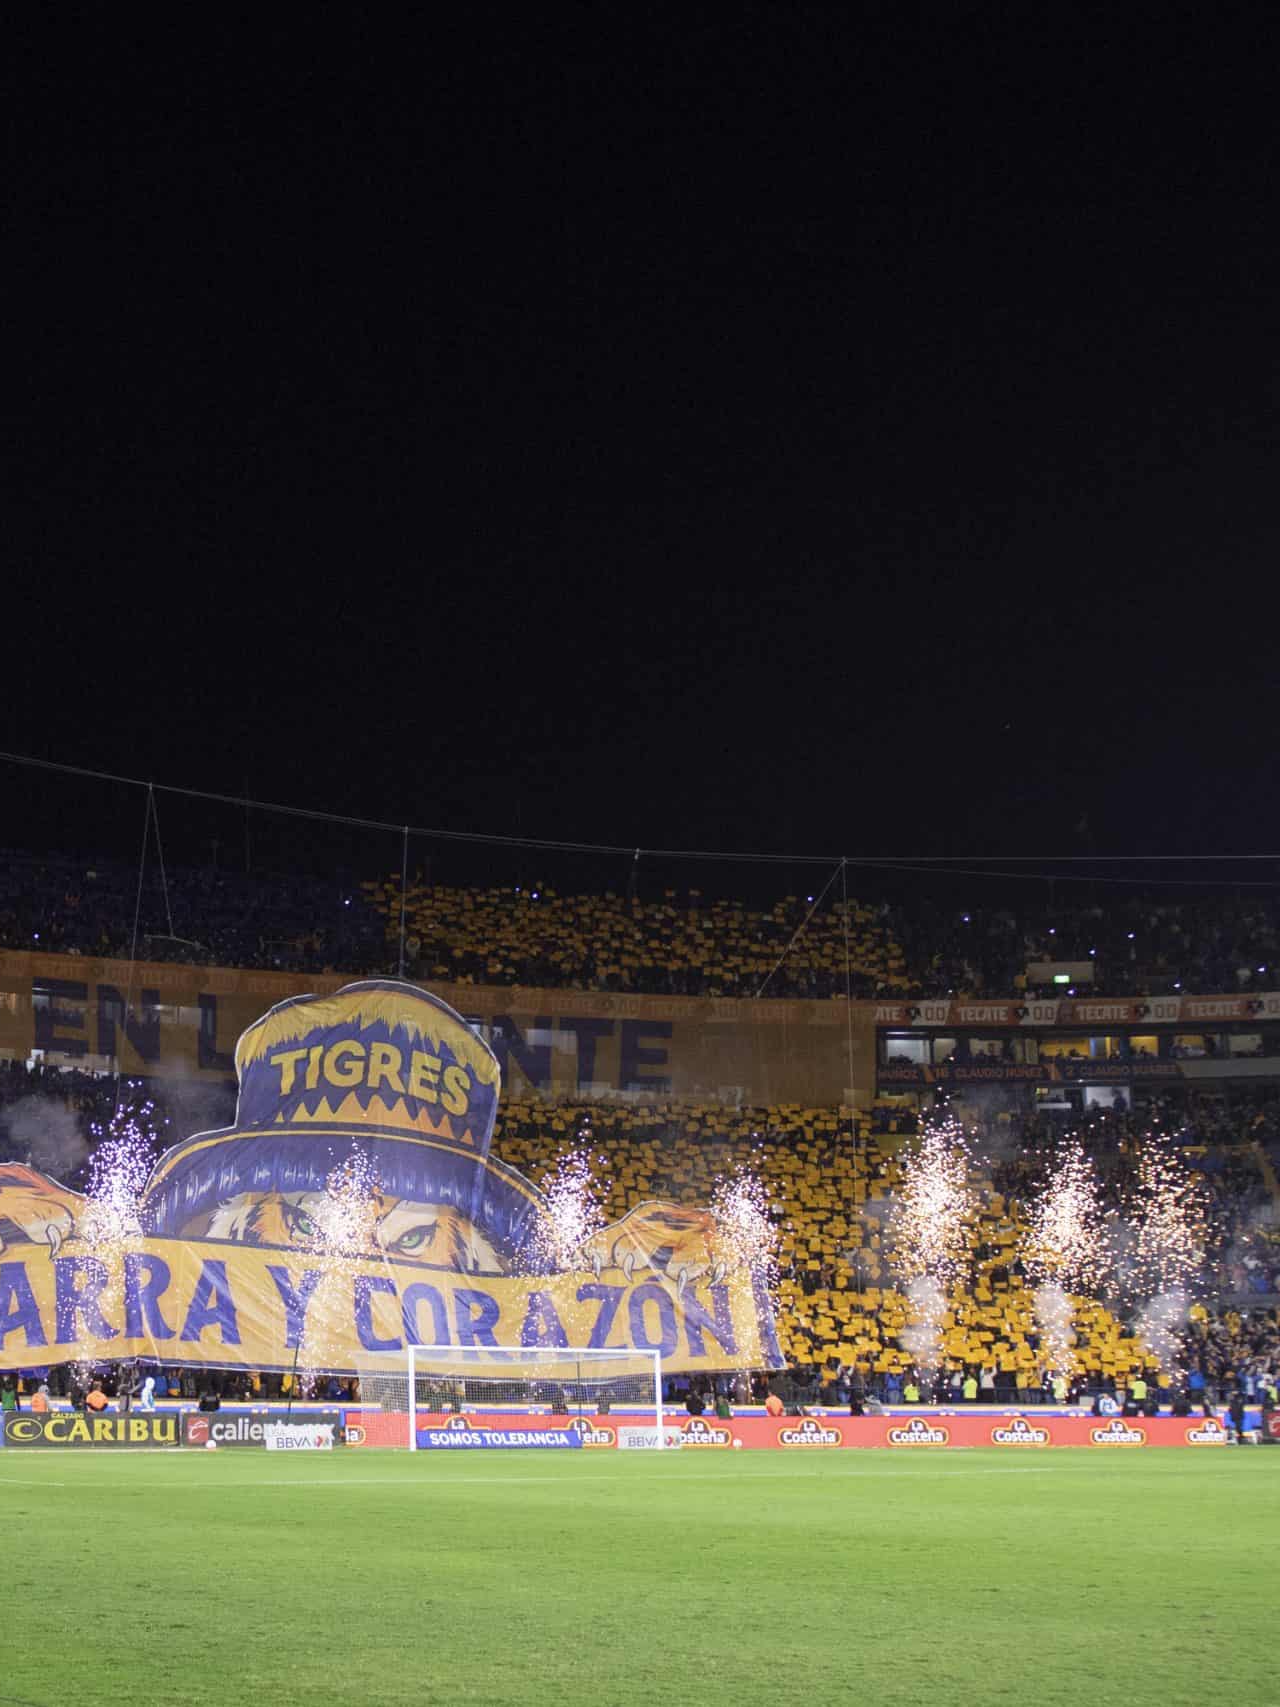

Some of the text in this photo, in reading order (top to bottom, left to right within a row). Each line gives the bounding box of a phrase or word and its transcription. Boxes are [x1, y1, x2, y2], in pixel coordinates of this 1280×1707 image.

[958, 1006, 1009, 1023] TECATE
[1075, 1004, 1129, 1020] TECATE
[32, 976, 160, 1063] EN
[198, 992, 239, 1070] L
[472, 1014, 672, 1096] NTE
[270, 1039, 471, 1117] TIGRES
[266, 1264, 326, 1349] Y
[43, 1418, 176, 1442] CARIBU
[691, 1421, 704, 1431] La
[803, 1421, 816, 1431] La
[911, 1421, 924, 1431] La
[1014, 1421, 1026, 1431] La
[1112, 1421, 1123, 1431] La
[276, 1437, 311, 1448] BBVA
[430, 1432, 569, 1446] SOMOS TOLERANCIA
[679, 1430, 726, 1443] osteña
[782, 1431, 836, 1443] Costeña
[892, 1430, 944, 1443] Costeña
